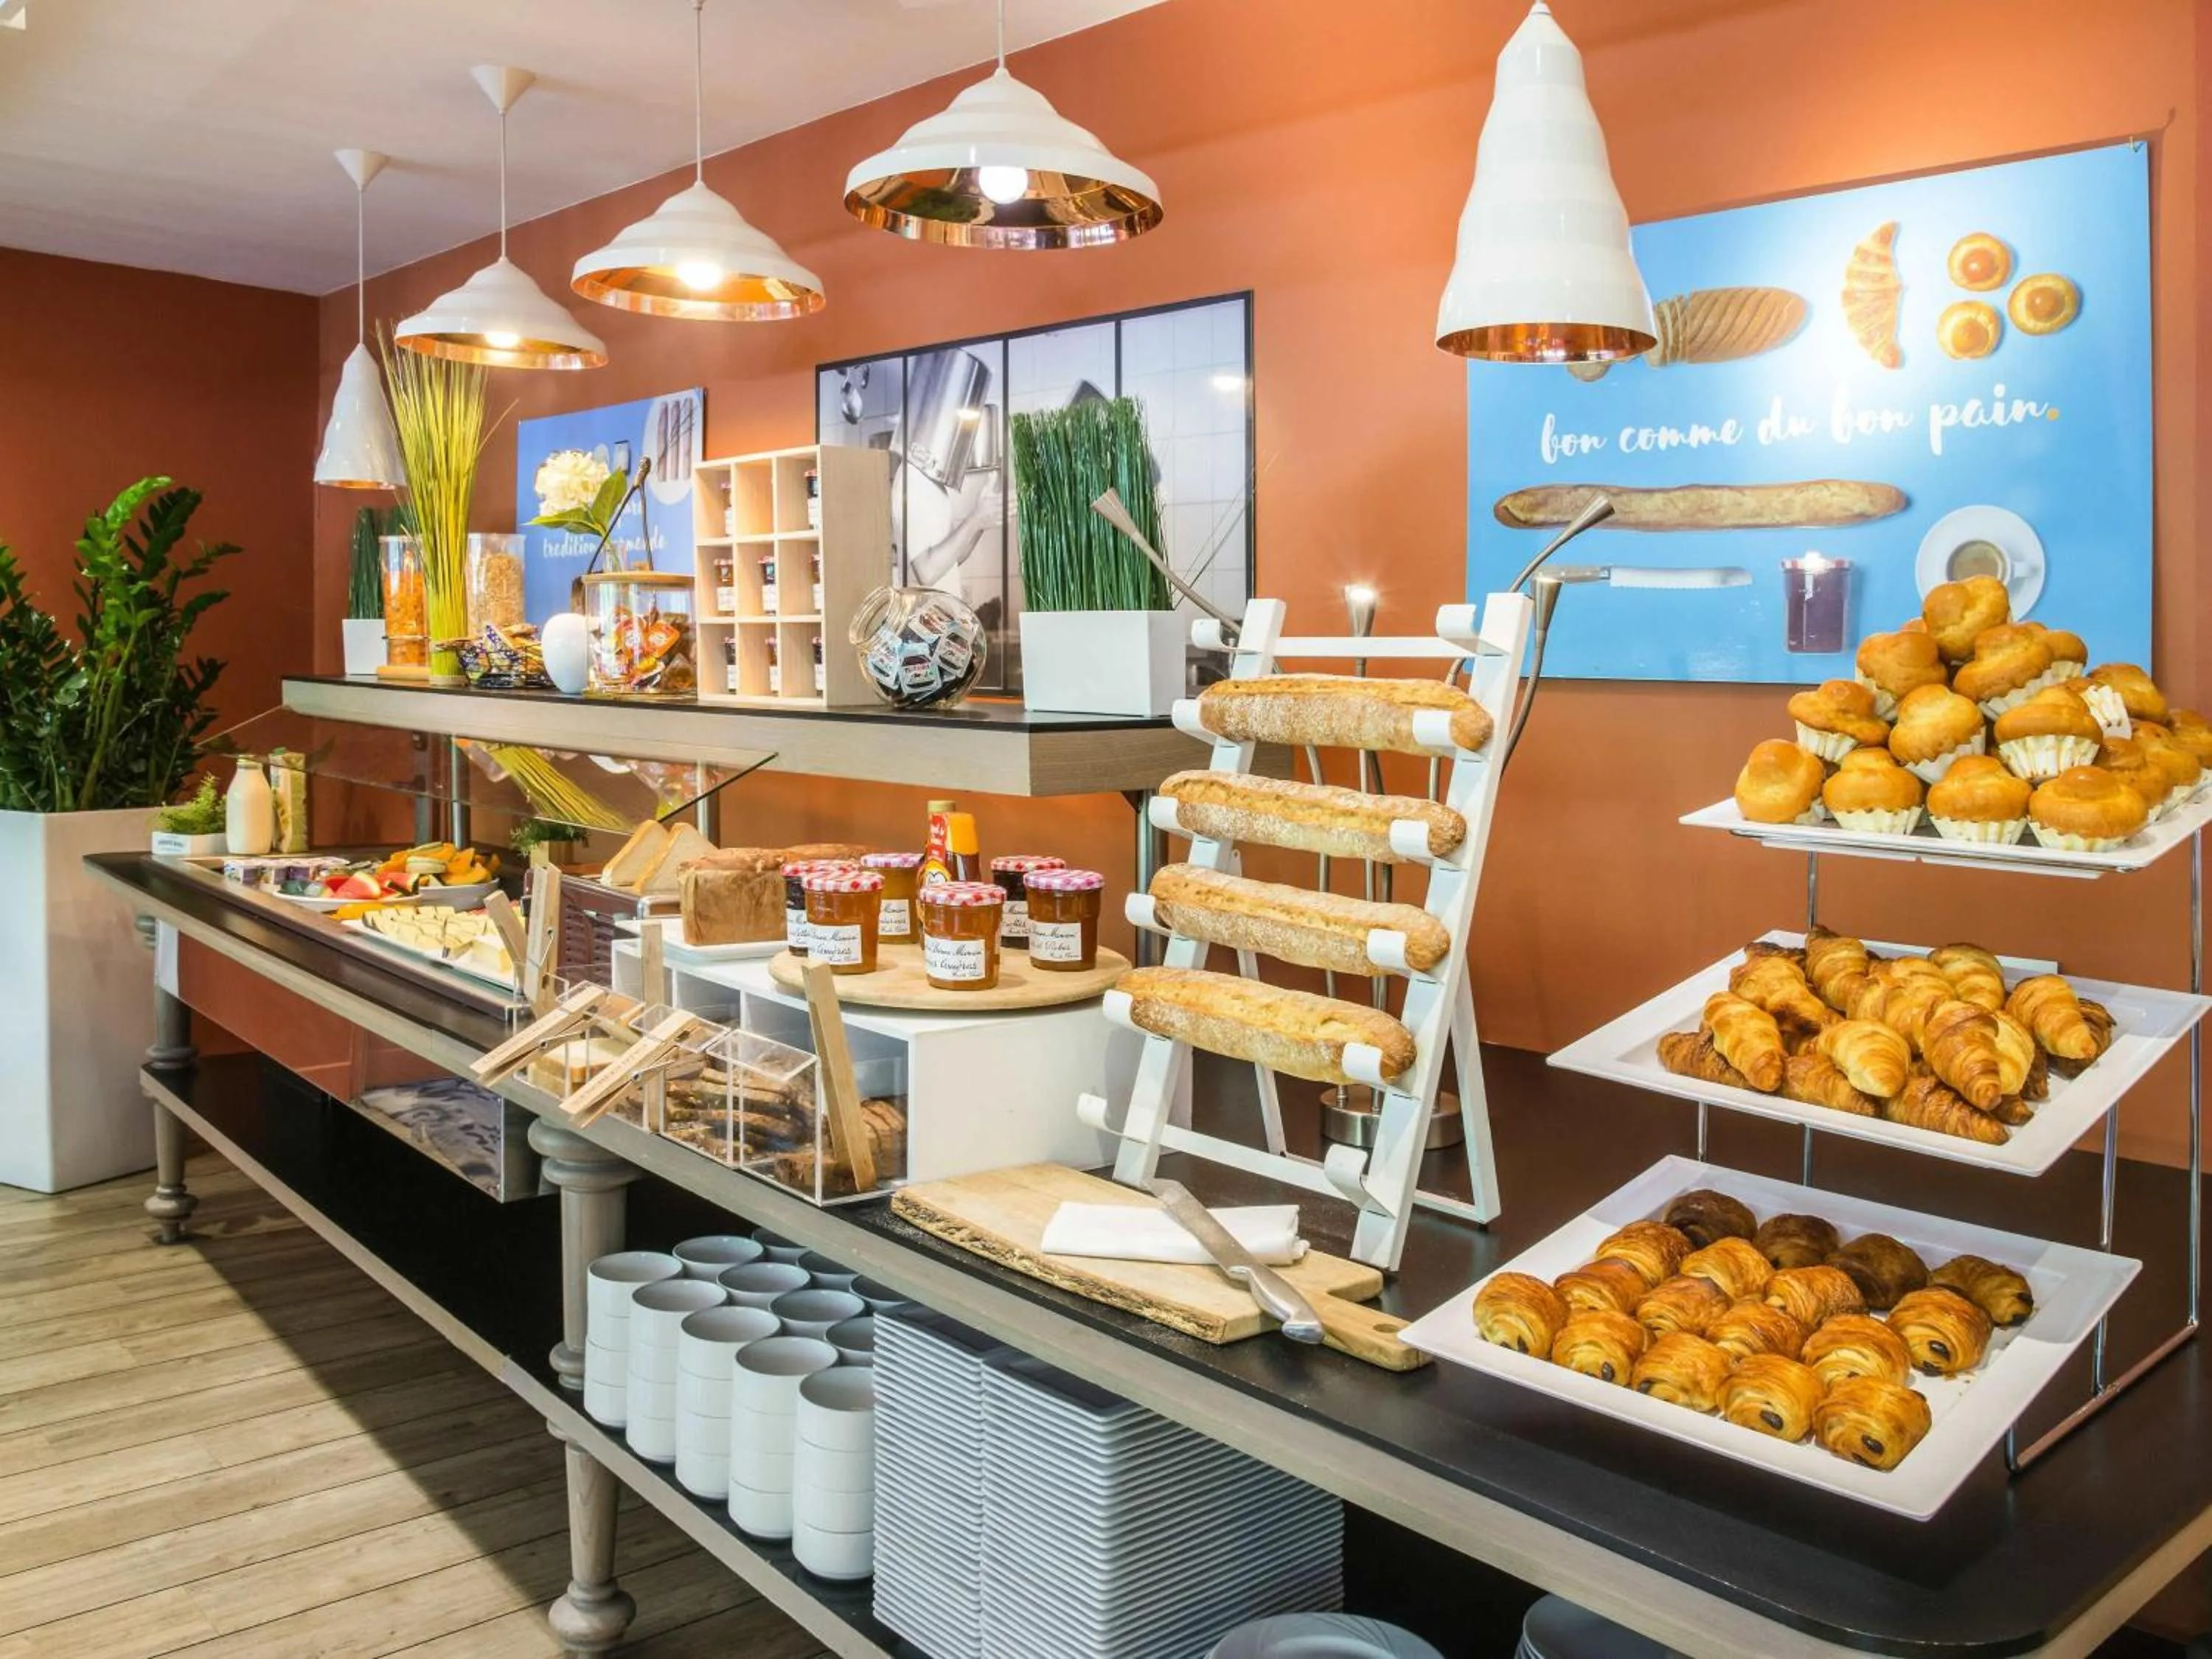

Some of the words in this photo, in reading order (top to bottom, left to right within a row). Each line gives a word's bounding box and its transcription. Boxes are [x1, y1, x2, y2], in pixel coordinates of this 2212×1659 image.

[1541, 413, 1607, 464] bon
[1619, 418, 1744, 453] comme
[1757, 394, 1817, 445] du
[1830, 383, 1914, 444] bon
